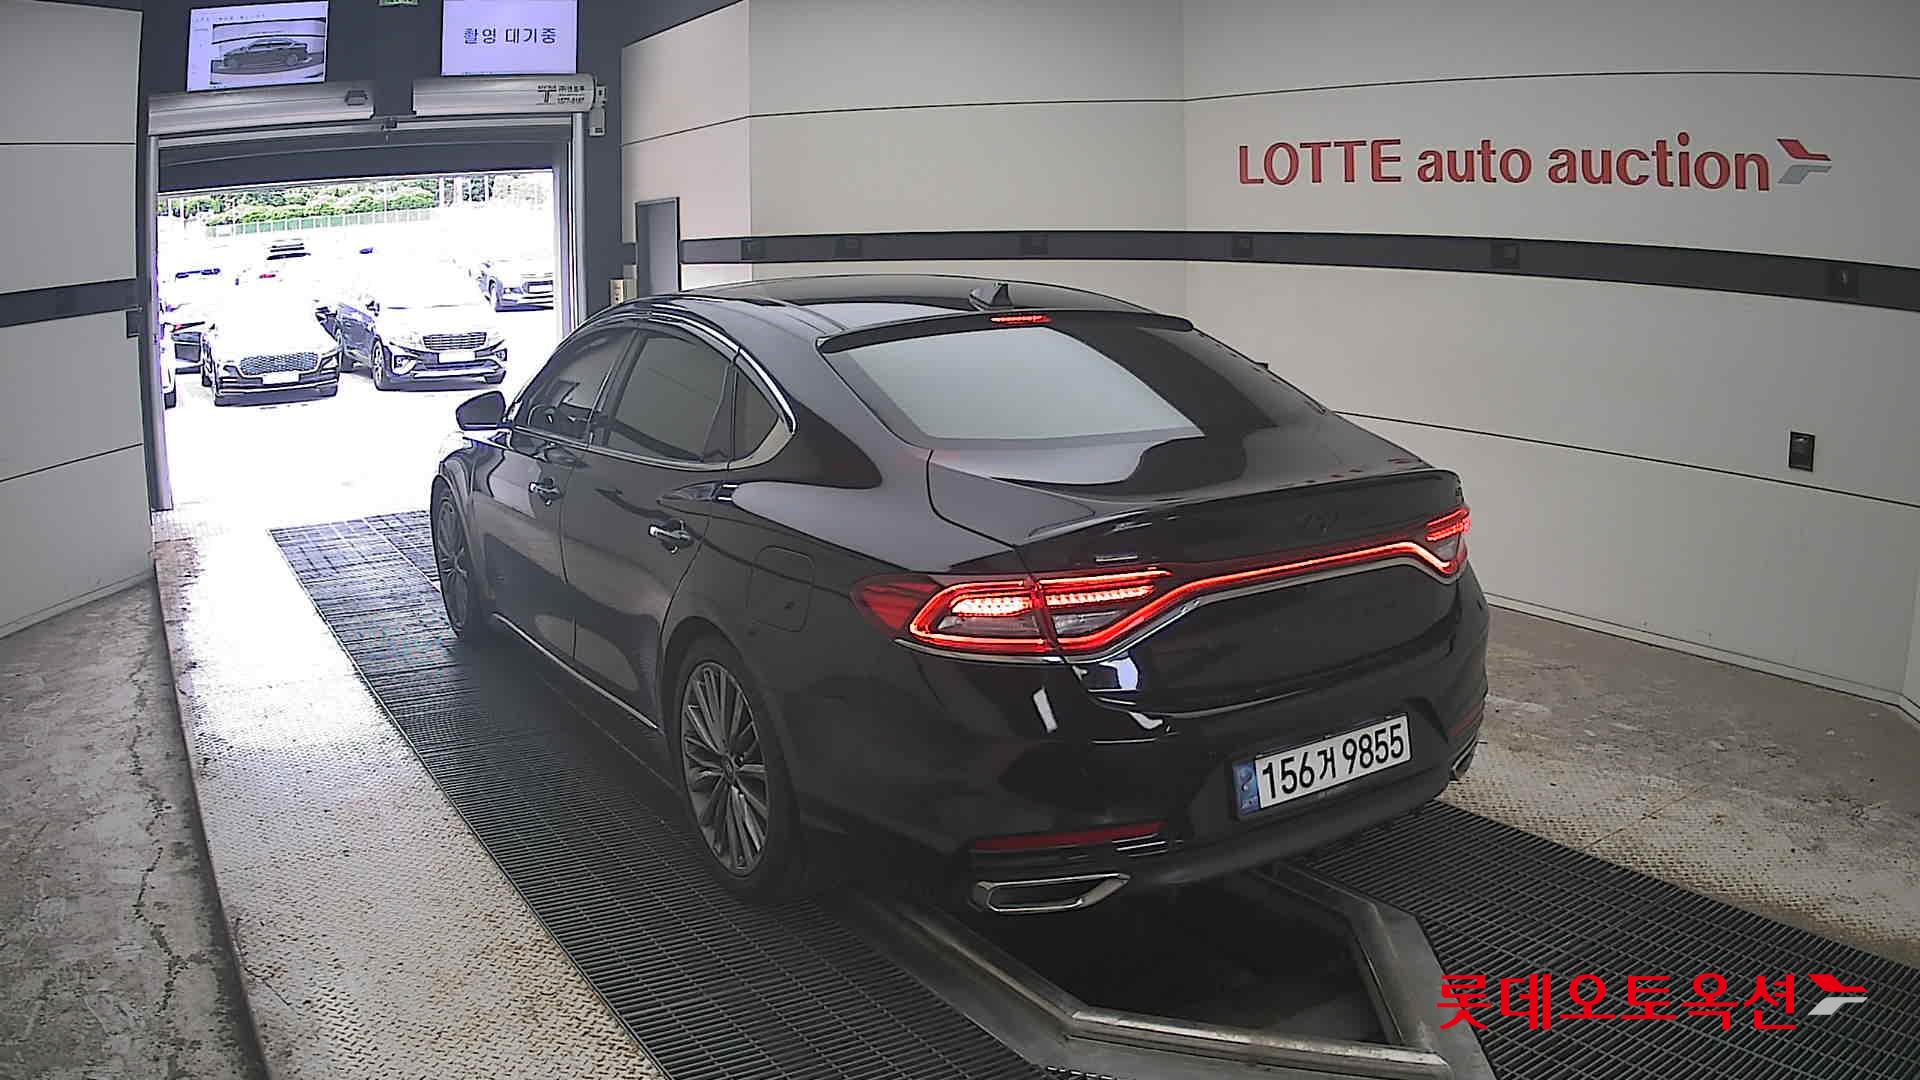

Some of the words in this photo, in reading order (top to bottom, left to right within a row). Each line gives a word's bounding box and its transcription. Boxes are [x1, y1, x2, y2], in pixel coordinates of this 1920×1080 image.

[464, 28, 496, 45] 촬영
[505, 27, 557, 45] 대기중
[1238, 139, 1402, 186] LOTTE
[1417, 140, 1533, 185] auto
[1548, 132, 1771, 191] auction
[1262, 746, 1337, 799] 156거
[1342, 723, 1404, 774] 9855
